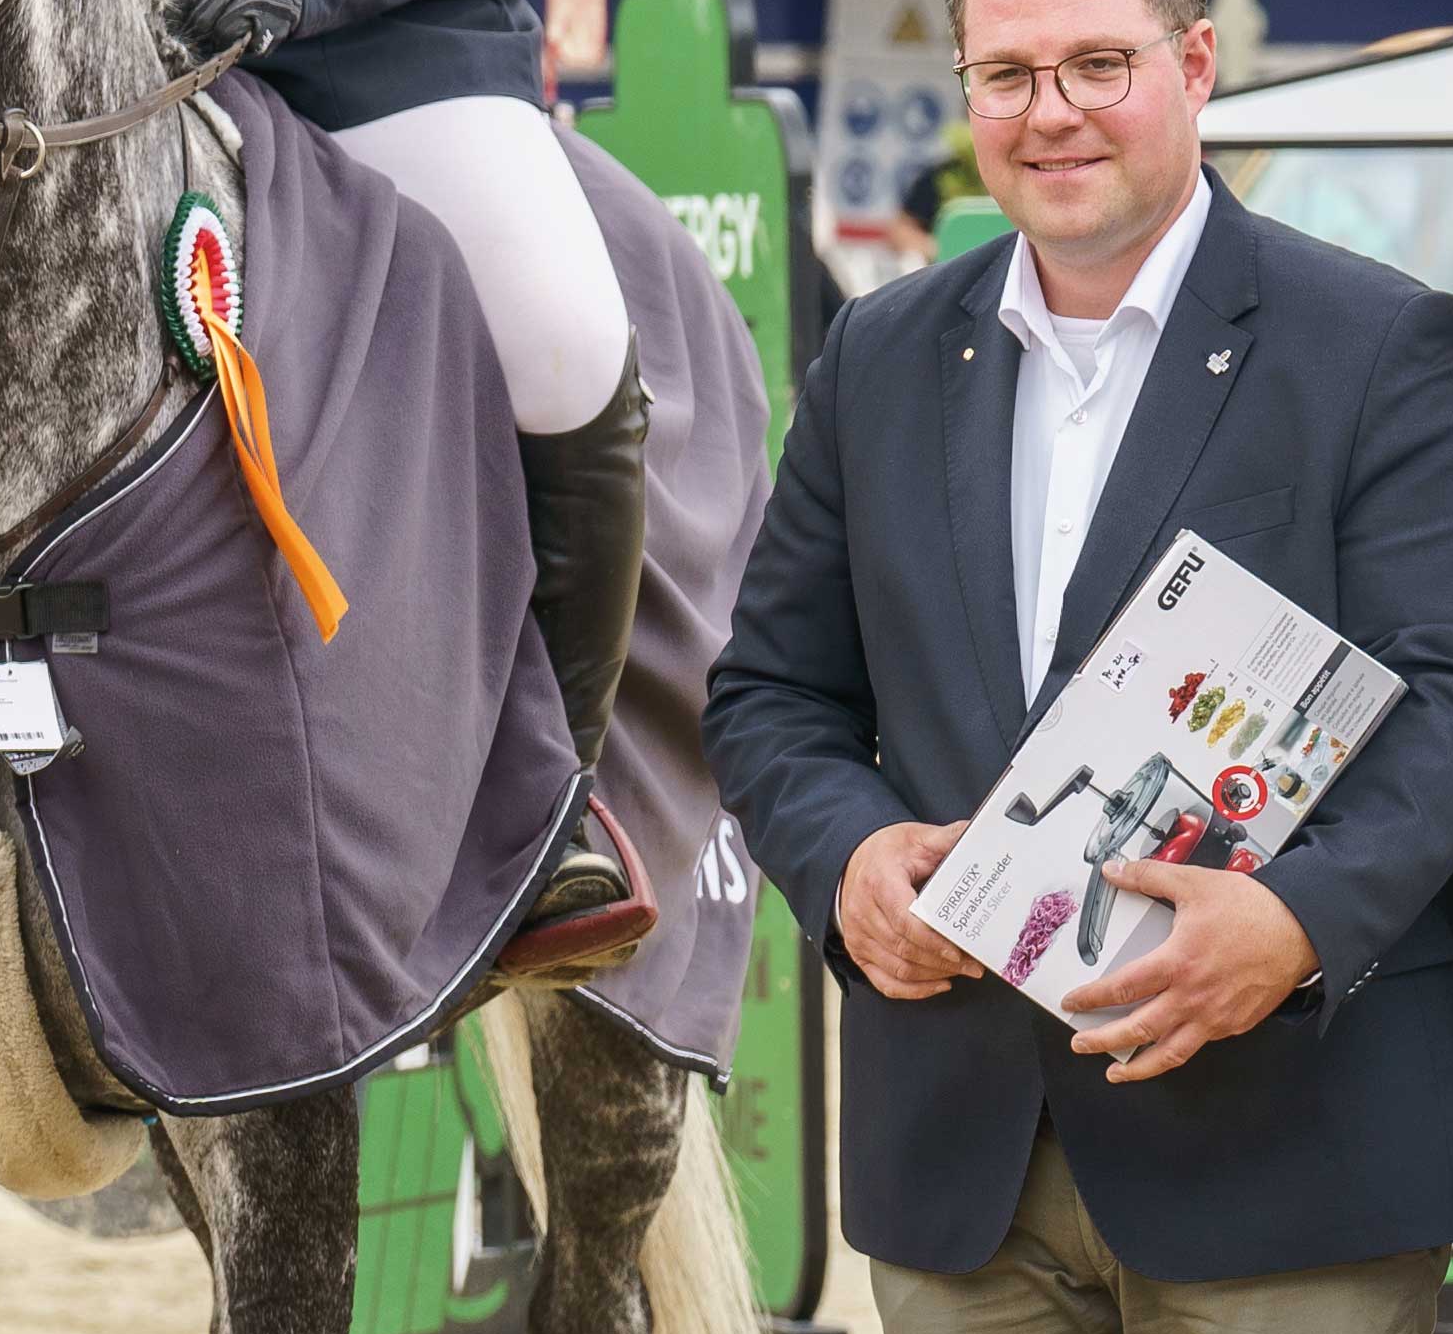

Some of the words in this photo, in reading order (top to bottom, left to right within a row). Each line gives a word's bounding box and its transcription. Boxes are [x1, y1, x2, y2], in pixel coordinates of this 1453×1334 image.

[952, 852, 1013, 932] Spiralschneider
[965, 908, 992, 941] Spiral
[987, 881, 1013, 911] Slicer
